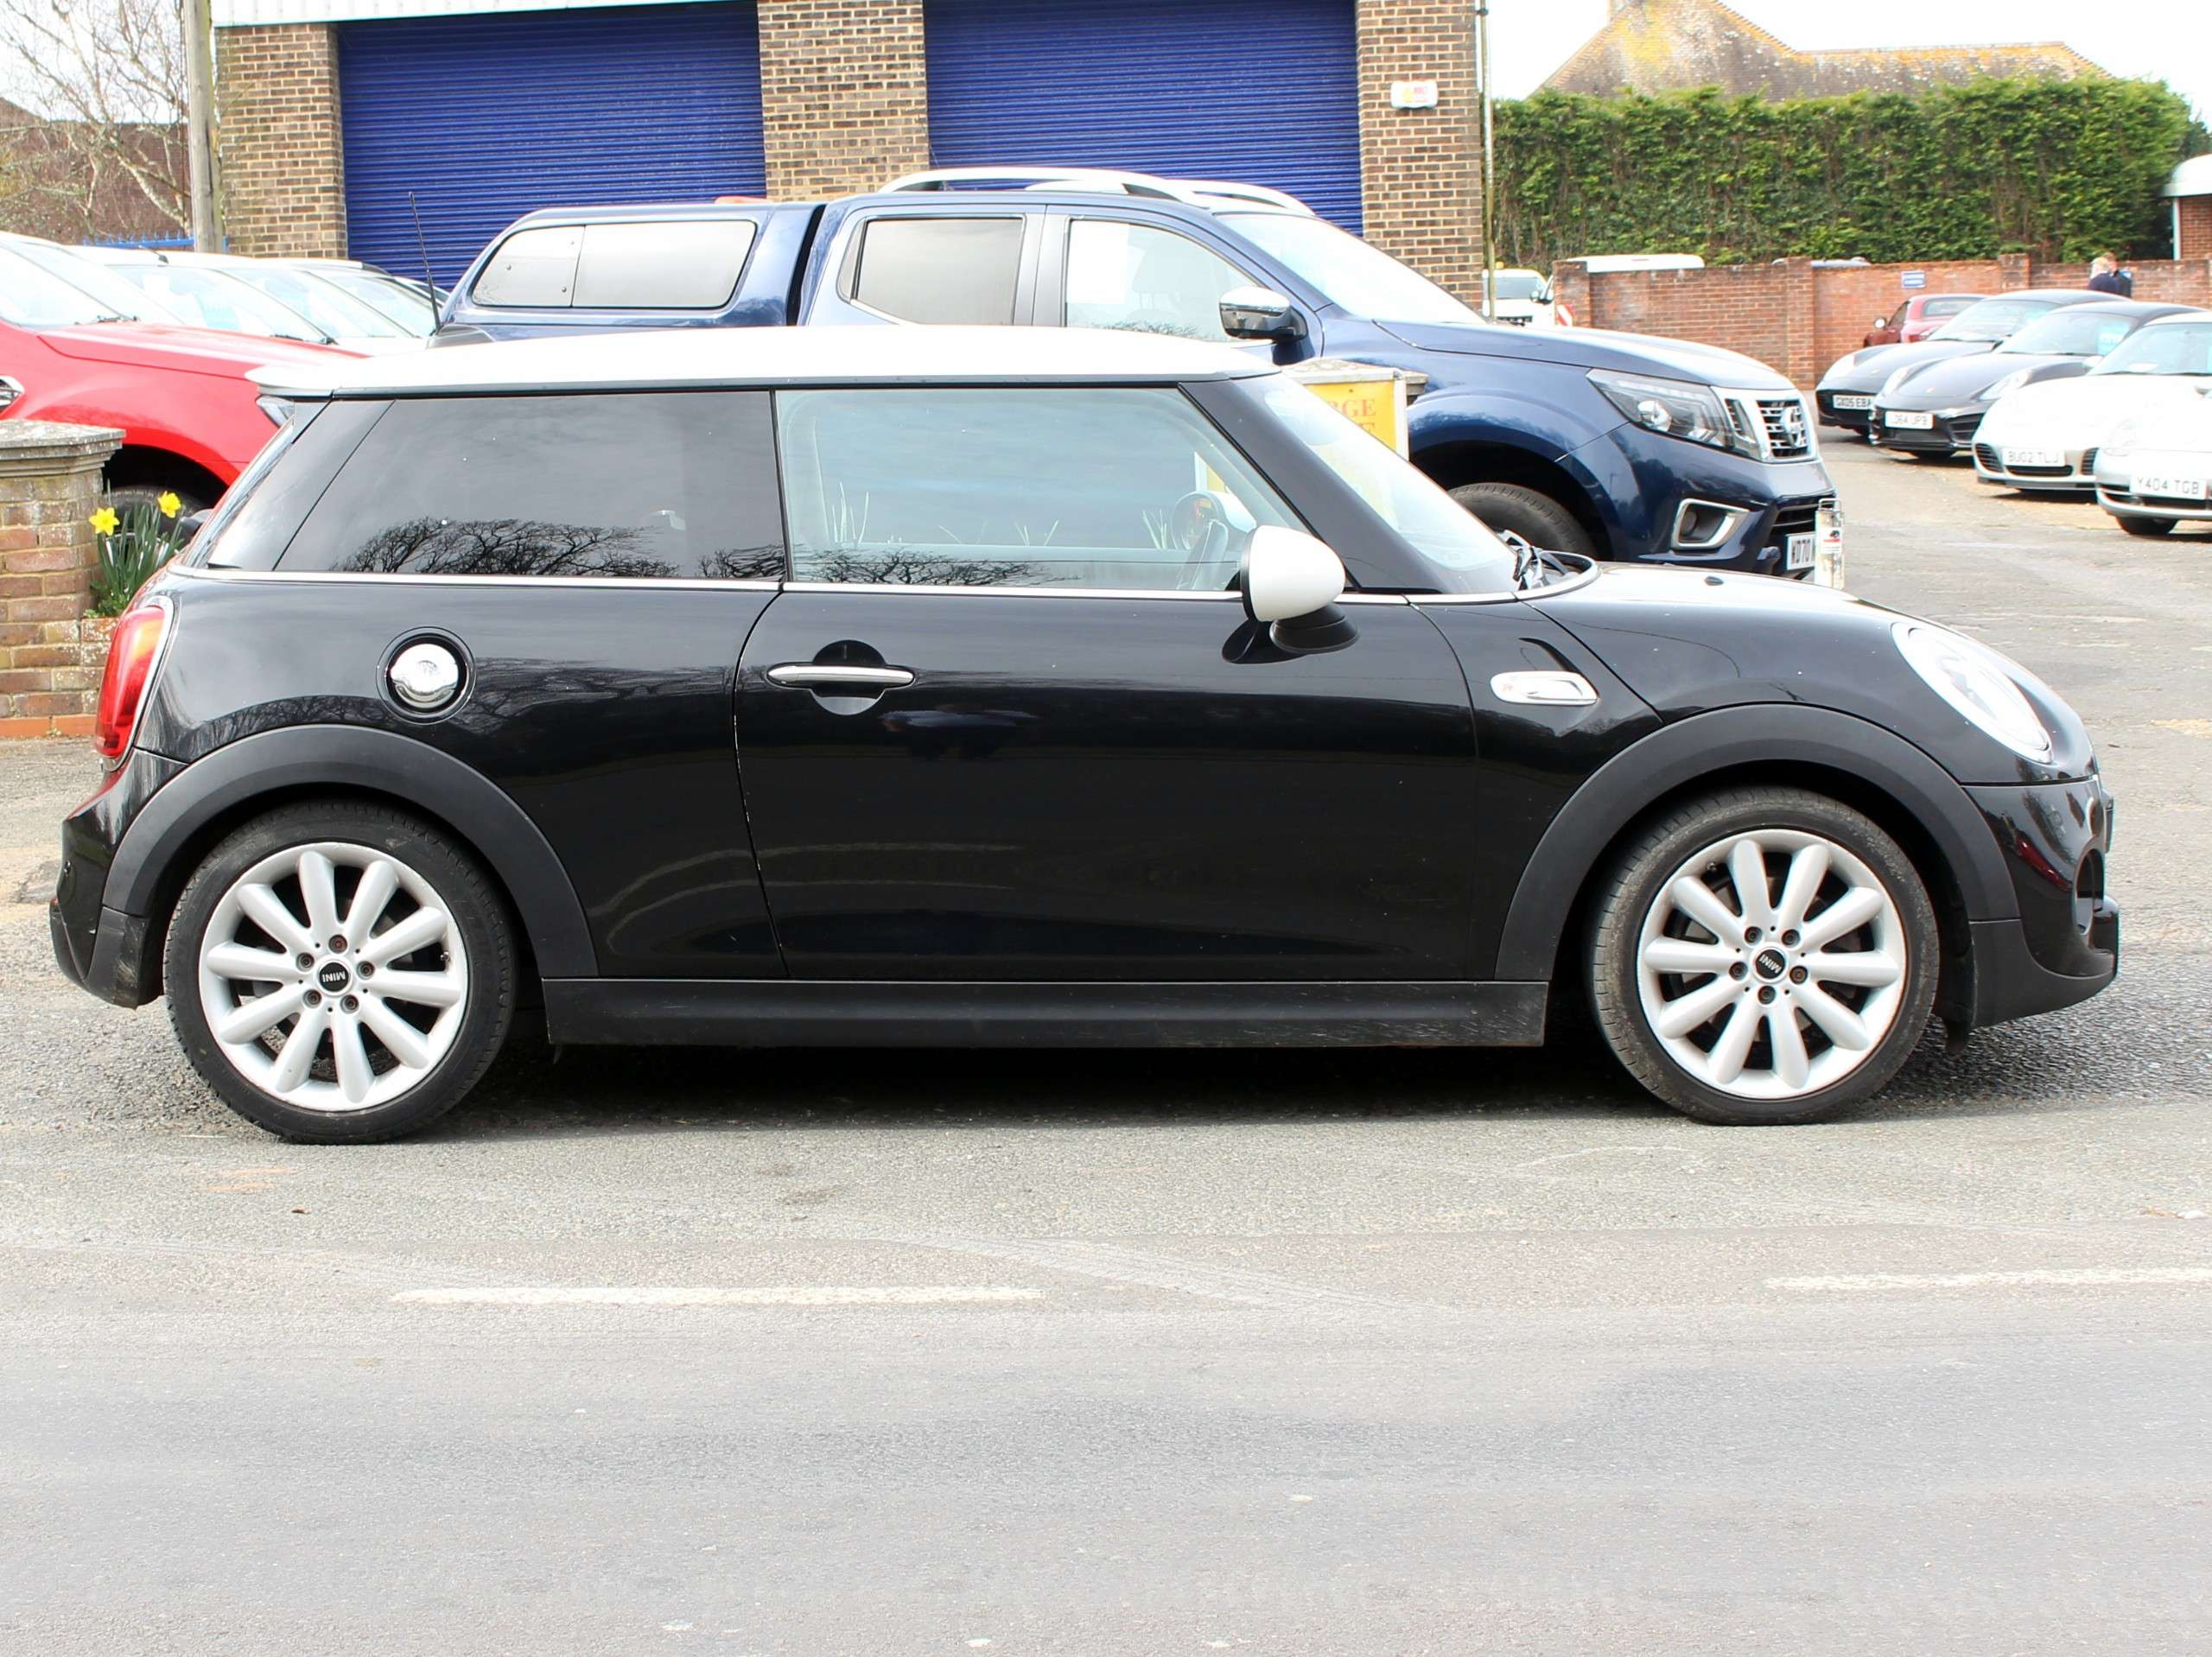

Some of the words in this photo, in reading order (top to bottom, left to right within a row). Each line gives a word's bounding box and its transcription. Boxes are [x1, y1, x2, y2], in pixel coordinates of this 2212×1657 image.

[1328, 398, 1376, 417] GE
[2137, 476, 2168, 491] Y404
[2174, 479, 2199, 495] TGB
[1759, 954, 1782, 974] MINI
[322, 971, 346, 982] MINI
